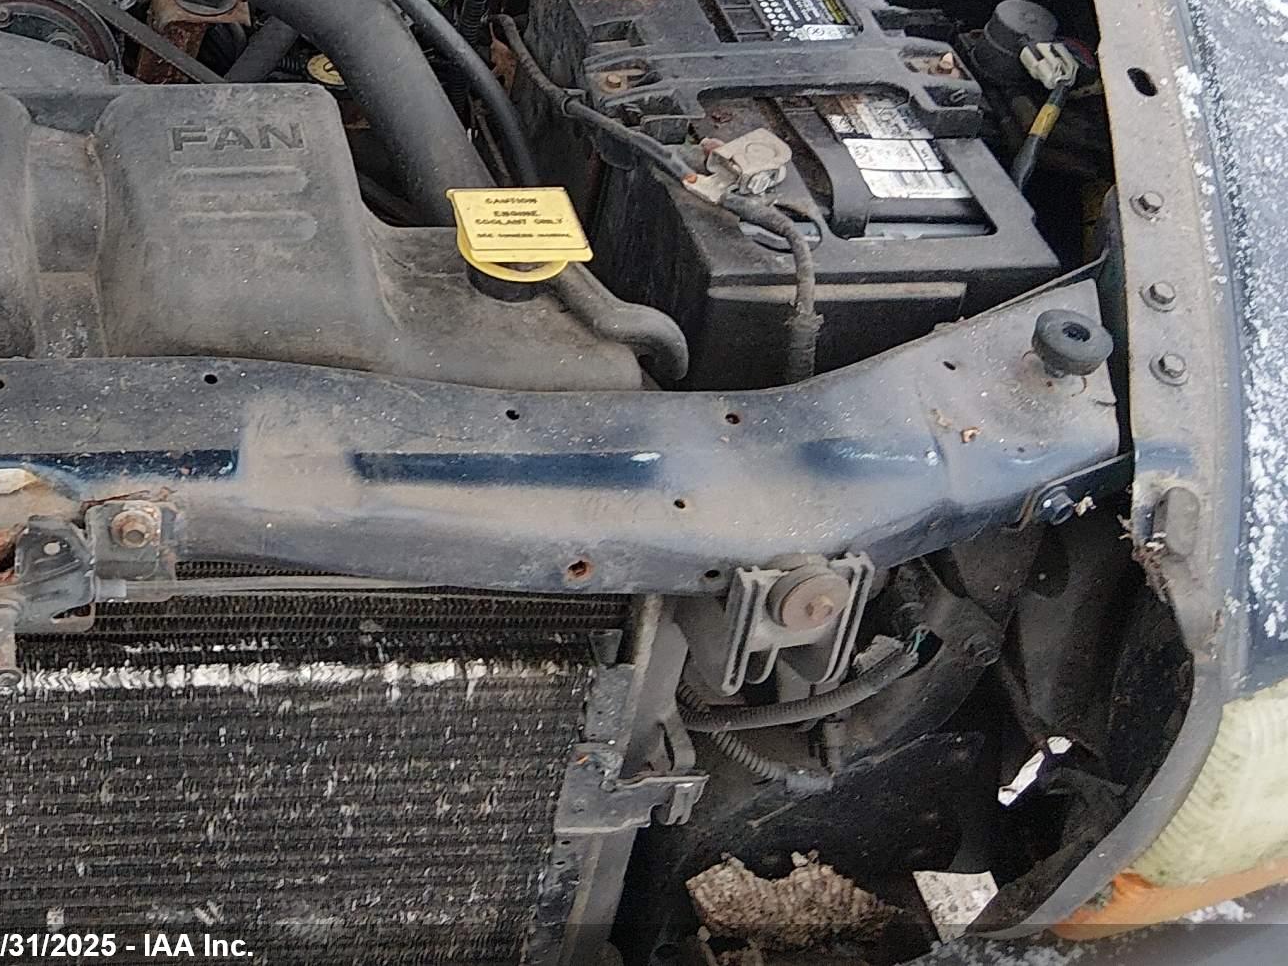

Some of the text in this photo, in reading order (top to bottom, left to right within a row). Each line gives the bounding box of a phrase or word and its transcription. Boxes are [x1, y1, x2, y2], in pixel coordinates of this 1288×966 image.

[171, 123, 304, 152] FAN
[484, 197, 538, 205] CAUTION
[493, 210, 541, 218] ENGINE
[475, 217, 564, 226] COOLANT ONLY
